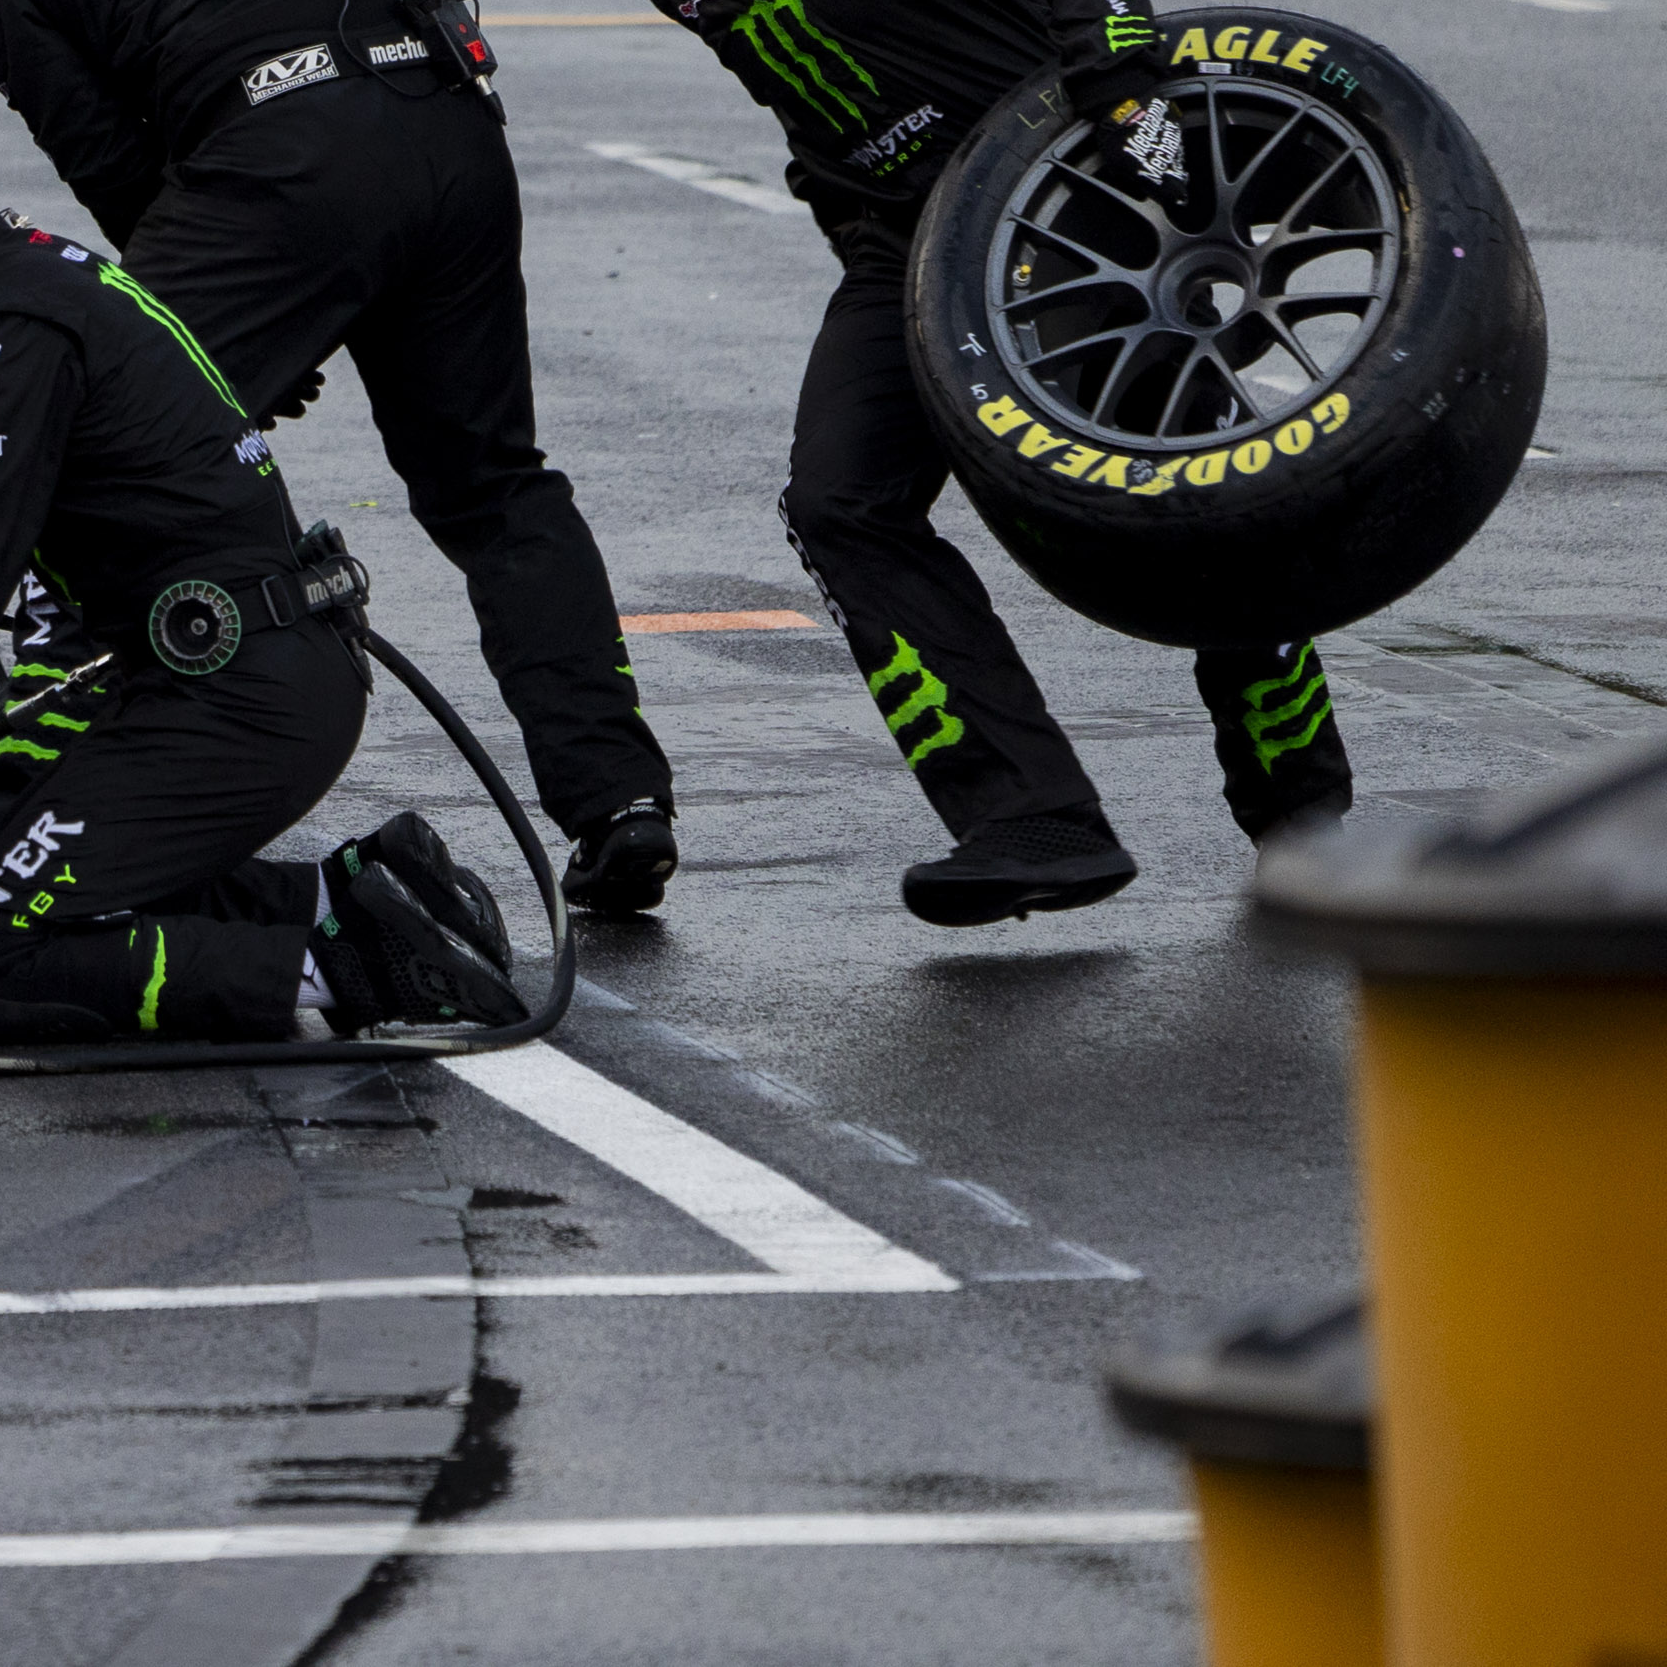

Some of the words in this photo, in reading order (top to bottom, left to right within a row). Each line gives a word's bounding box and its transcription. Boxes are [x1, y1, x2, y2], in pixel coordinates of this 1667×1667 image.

[369, 35, 430, 65] mecha
[1160, 25, 1329, 73] AGLE
[252, 75, 306, 104] MECHANIX
[305, 65, 337, 85] WEAR
[1320, 60, 1361, 99] LF4
[870, 133, 934, 178] NERGY
[976, 391, 1351, 497] GOODYEAR
